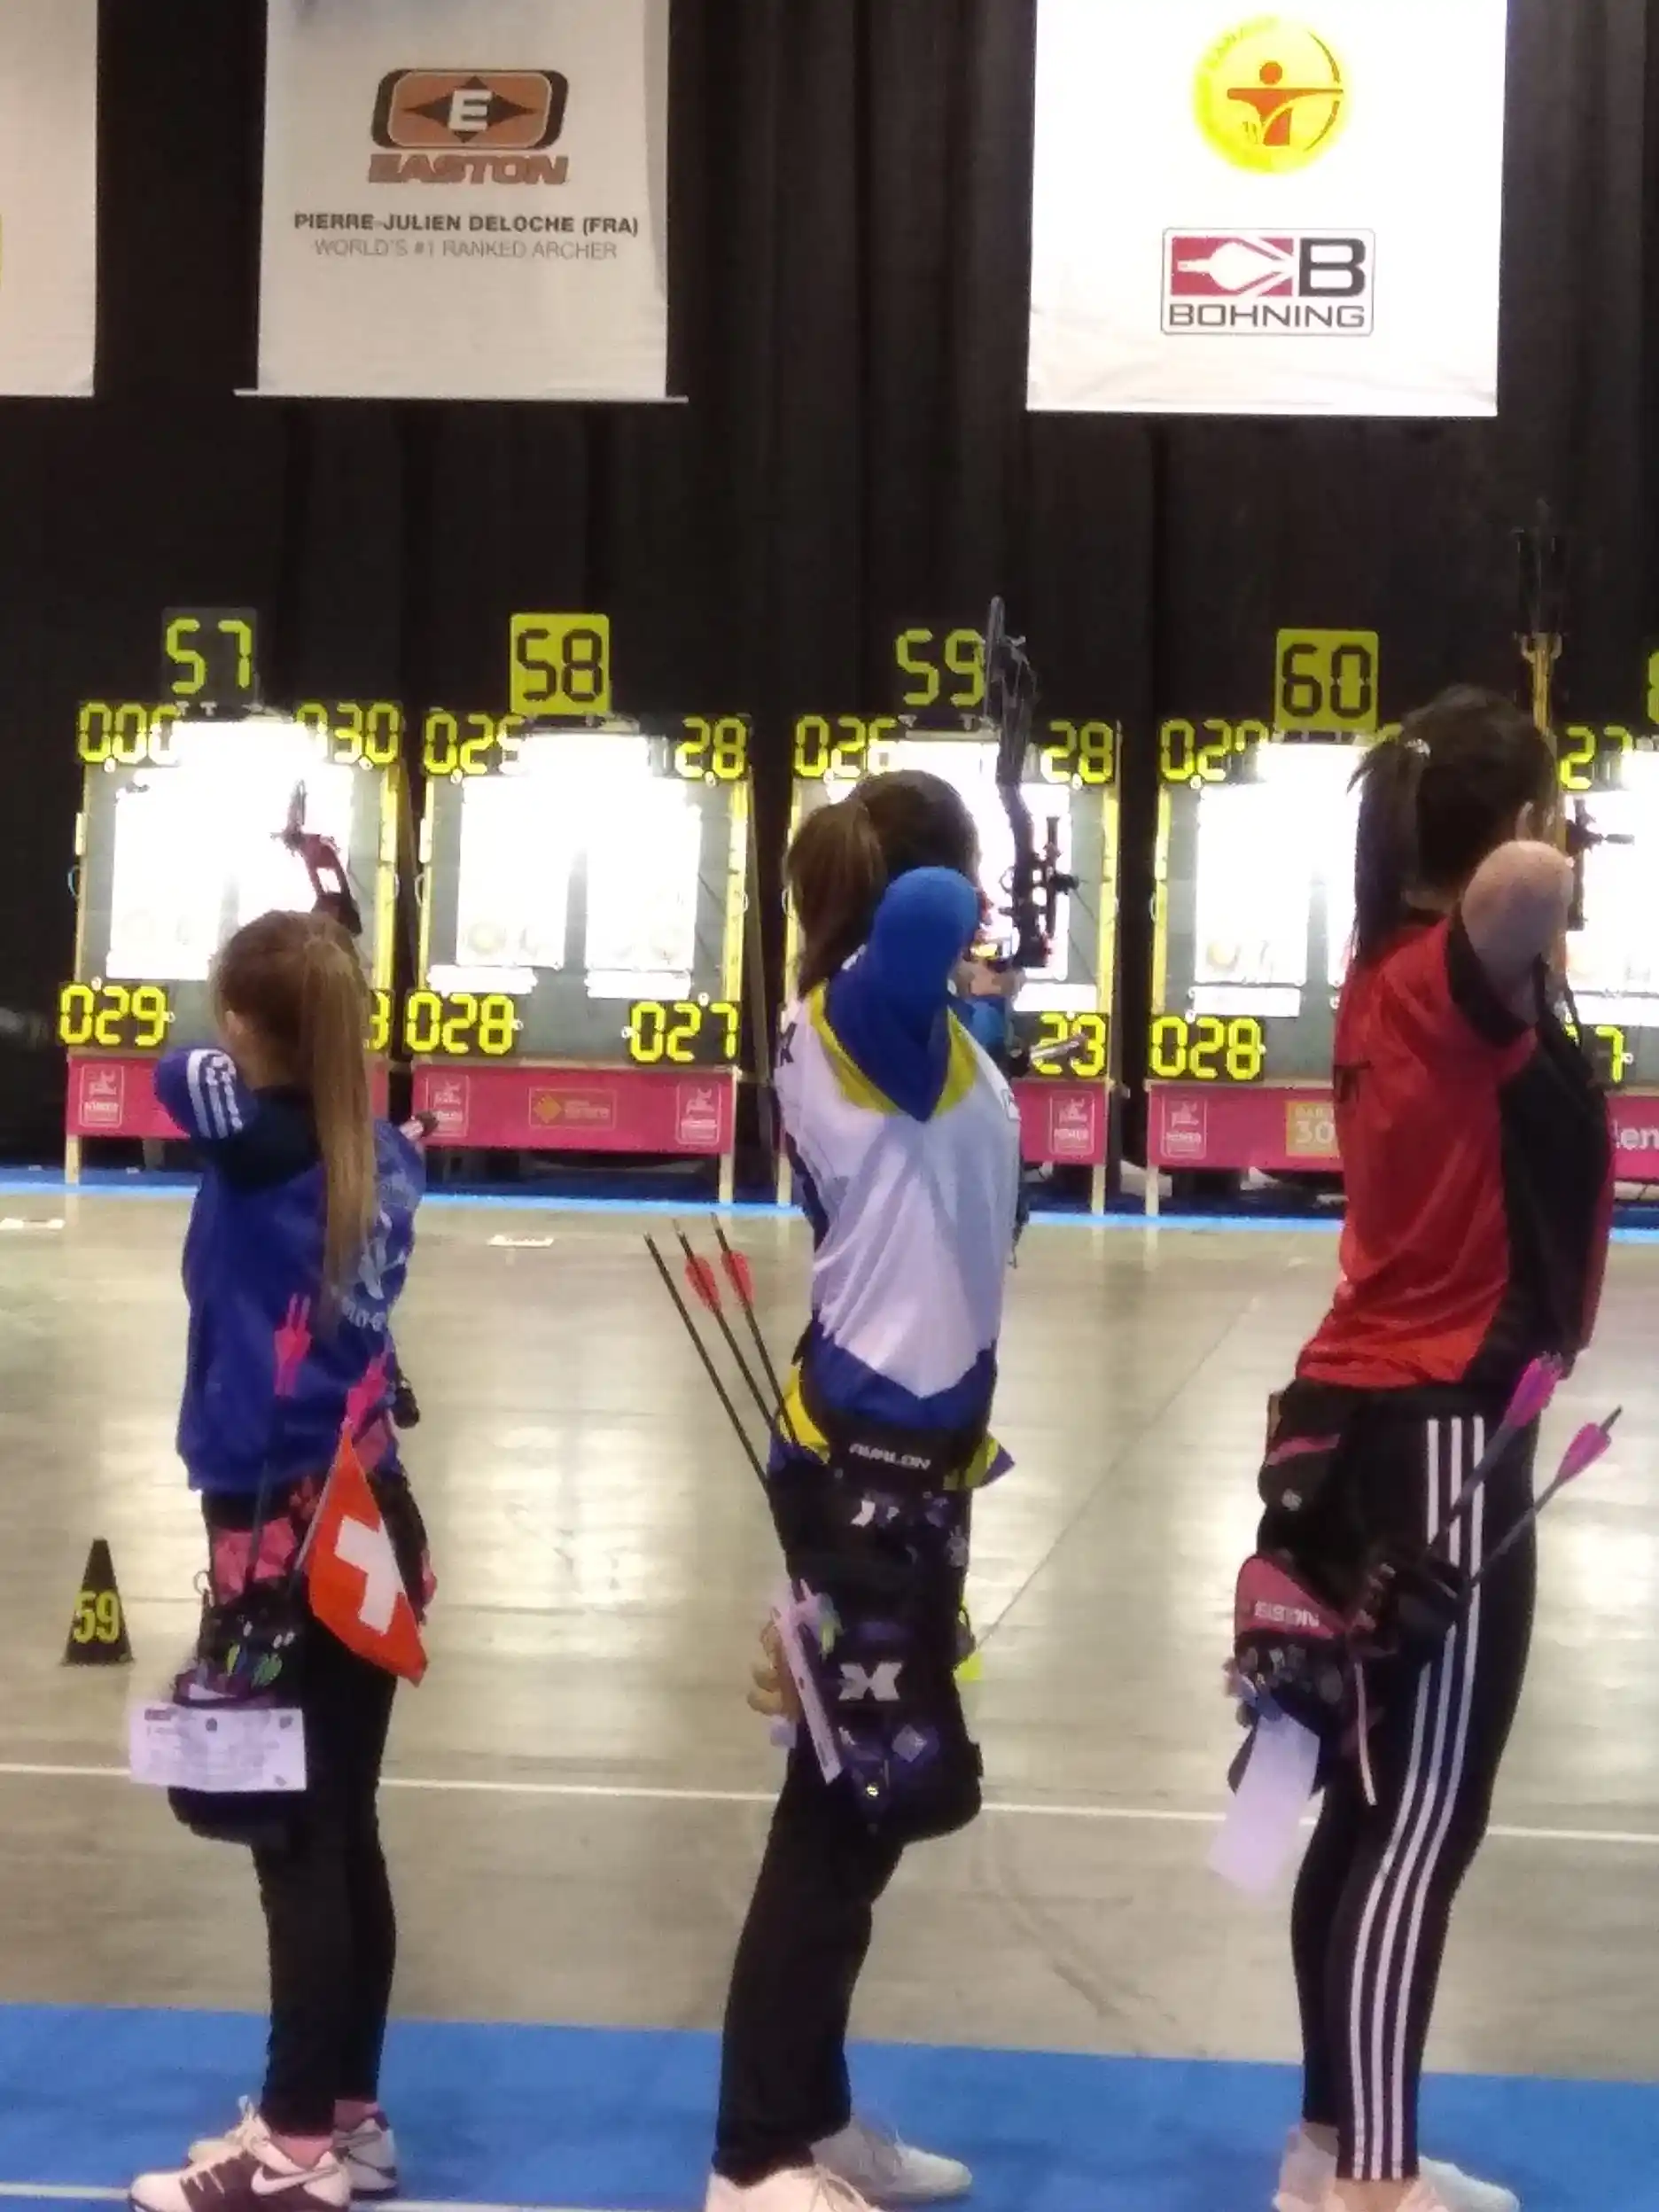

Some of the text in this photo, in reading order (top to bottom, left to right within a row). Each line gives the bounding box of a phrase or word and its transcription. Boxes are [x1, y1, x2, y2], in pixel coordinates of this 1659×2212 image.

[448, 90, 494, 131] E
[368, 154, 569, 184] EASTON
[294, 211, 638, 238] PIERRE-JULIEN DELOCHE (FRA)
[315, 238, 618, 261] WORLD'S #1 RANKED ARCHER
[1299, 237, 1367, 297] B
[1169, 303, 1366, 328] BOHNING
[166, 618, 253, 694] 57
[516, 627, 604, 703] 58
[896, 628, 985, 707] 59
[1281, 643, 1373, 718] 60
[59, 983, 169, 1048] 029
[405, 991, 516, 1055] 028
[628, 1001, 739, 1063] 027
[1150, 1016, 1262, 1081] 028
[73, 1590, 121, 1645] 59
